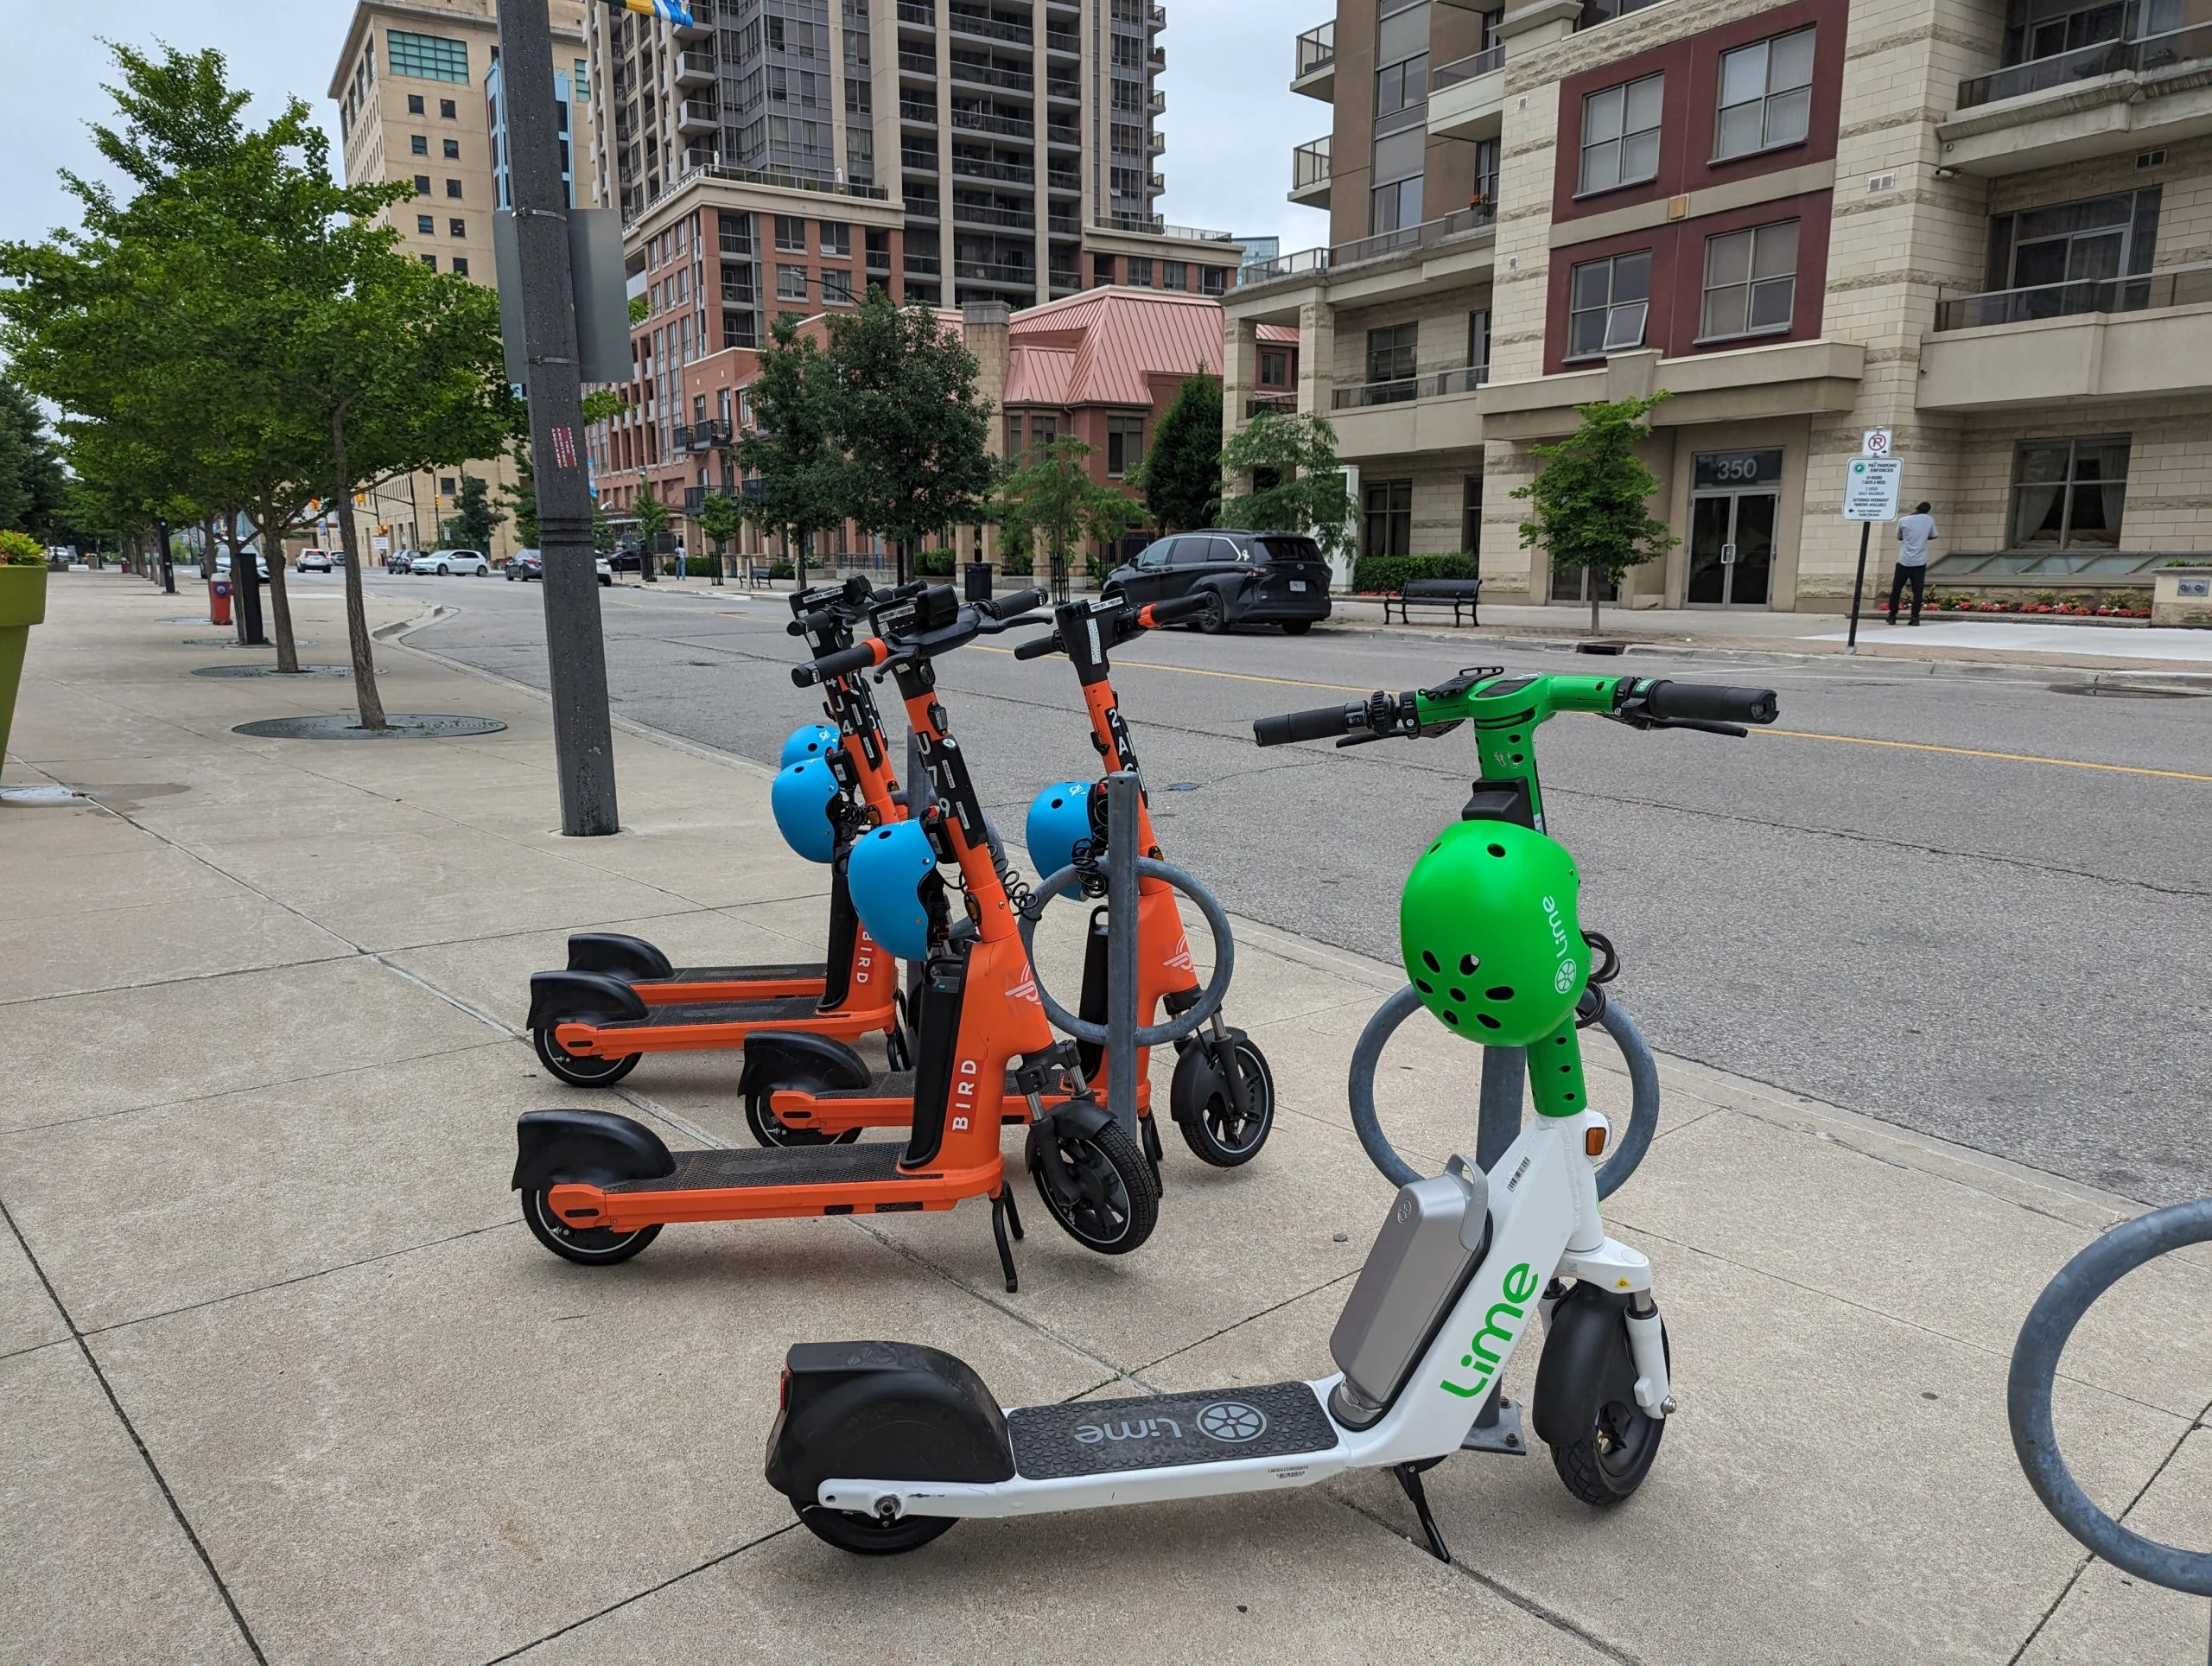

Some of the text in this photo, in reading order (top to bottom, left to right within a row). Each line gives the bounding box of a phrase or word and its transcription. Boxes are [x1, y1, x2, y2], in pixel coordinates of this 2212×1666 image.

[1717, 458, 1758, 480] 350
[1542, 895, 1568, 958] Lime
[951, 1059, 977, 1131] BIRD
[1440, 1262, 1539, 1398] Lime
[1073, 1417, 1183, 1444] Lime
